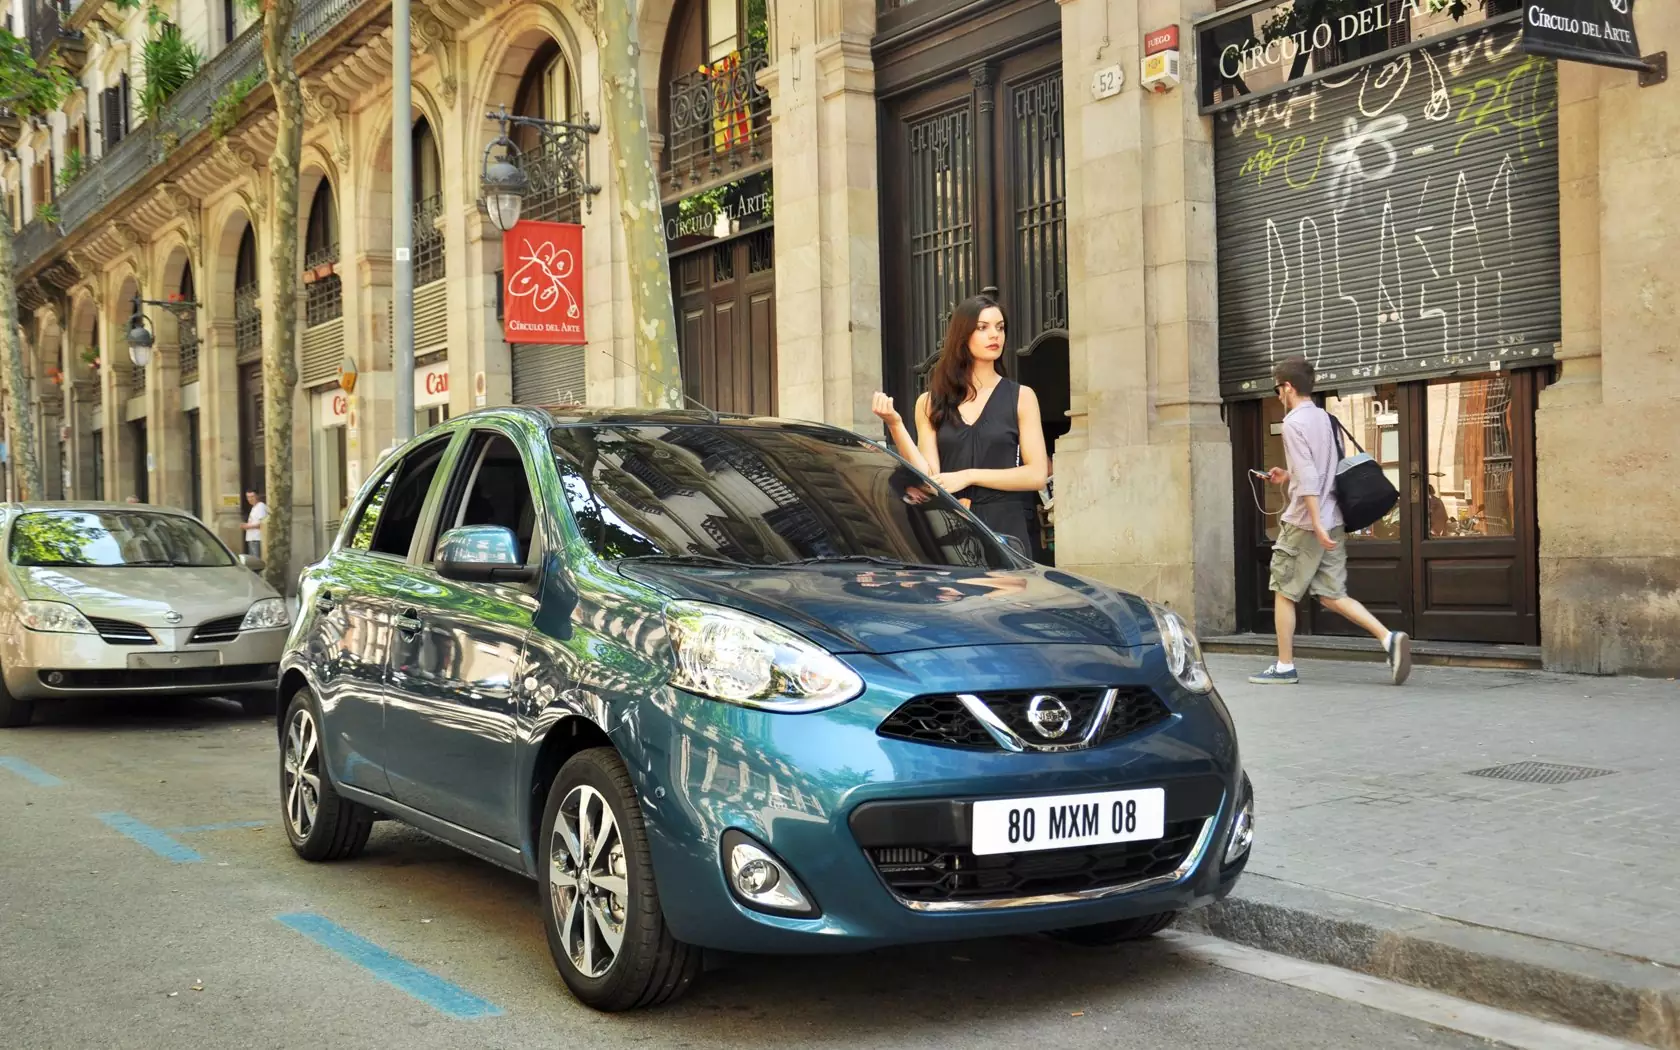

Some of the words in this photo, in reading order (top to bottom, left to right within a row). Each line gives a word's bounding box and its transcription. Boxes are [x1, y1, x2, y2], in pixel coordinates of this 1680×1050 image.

[1147, 33, 1171, 48] FUEGO
[1219, 23, 1332, 79] CÍRCULO
[1338, 3, 1393, 43] DEL
[1528, 5, 1579, 34] CÍRCULO
[1582, 21, 1602, 38] DEL
[1604, 20, 1632, 44] ARTE
[1100, 71, 1114, 92] 52
[666, 211, 713, 240] CÍRCULO
[737, 192, 768, 218] ARTE
[509, 320, 544, 332] CÍRCULO
[546, 323, 560, 332] DEL
[561, 322, 581, 333] ARTE
[1008, 808, 1036, 843] 80
[1049, 803, 1099, 840] MXM
[1112, 799, 1137, 834] 08
